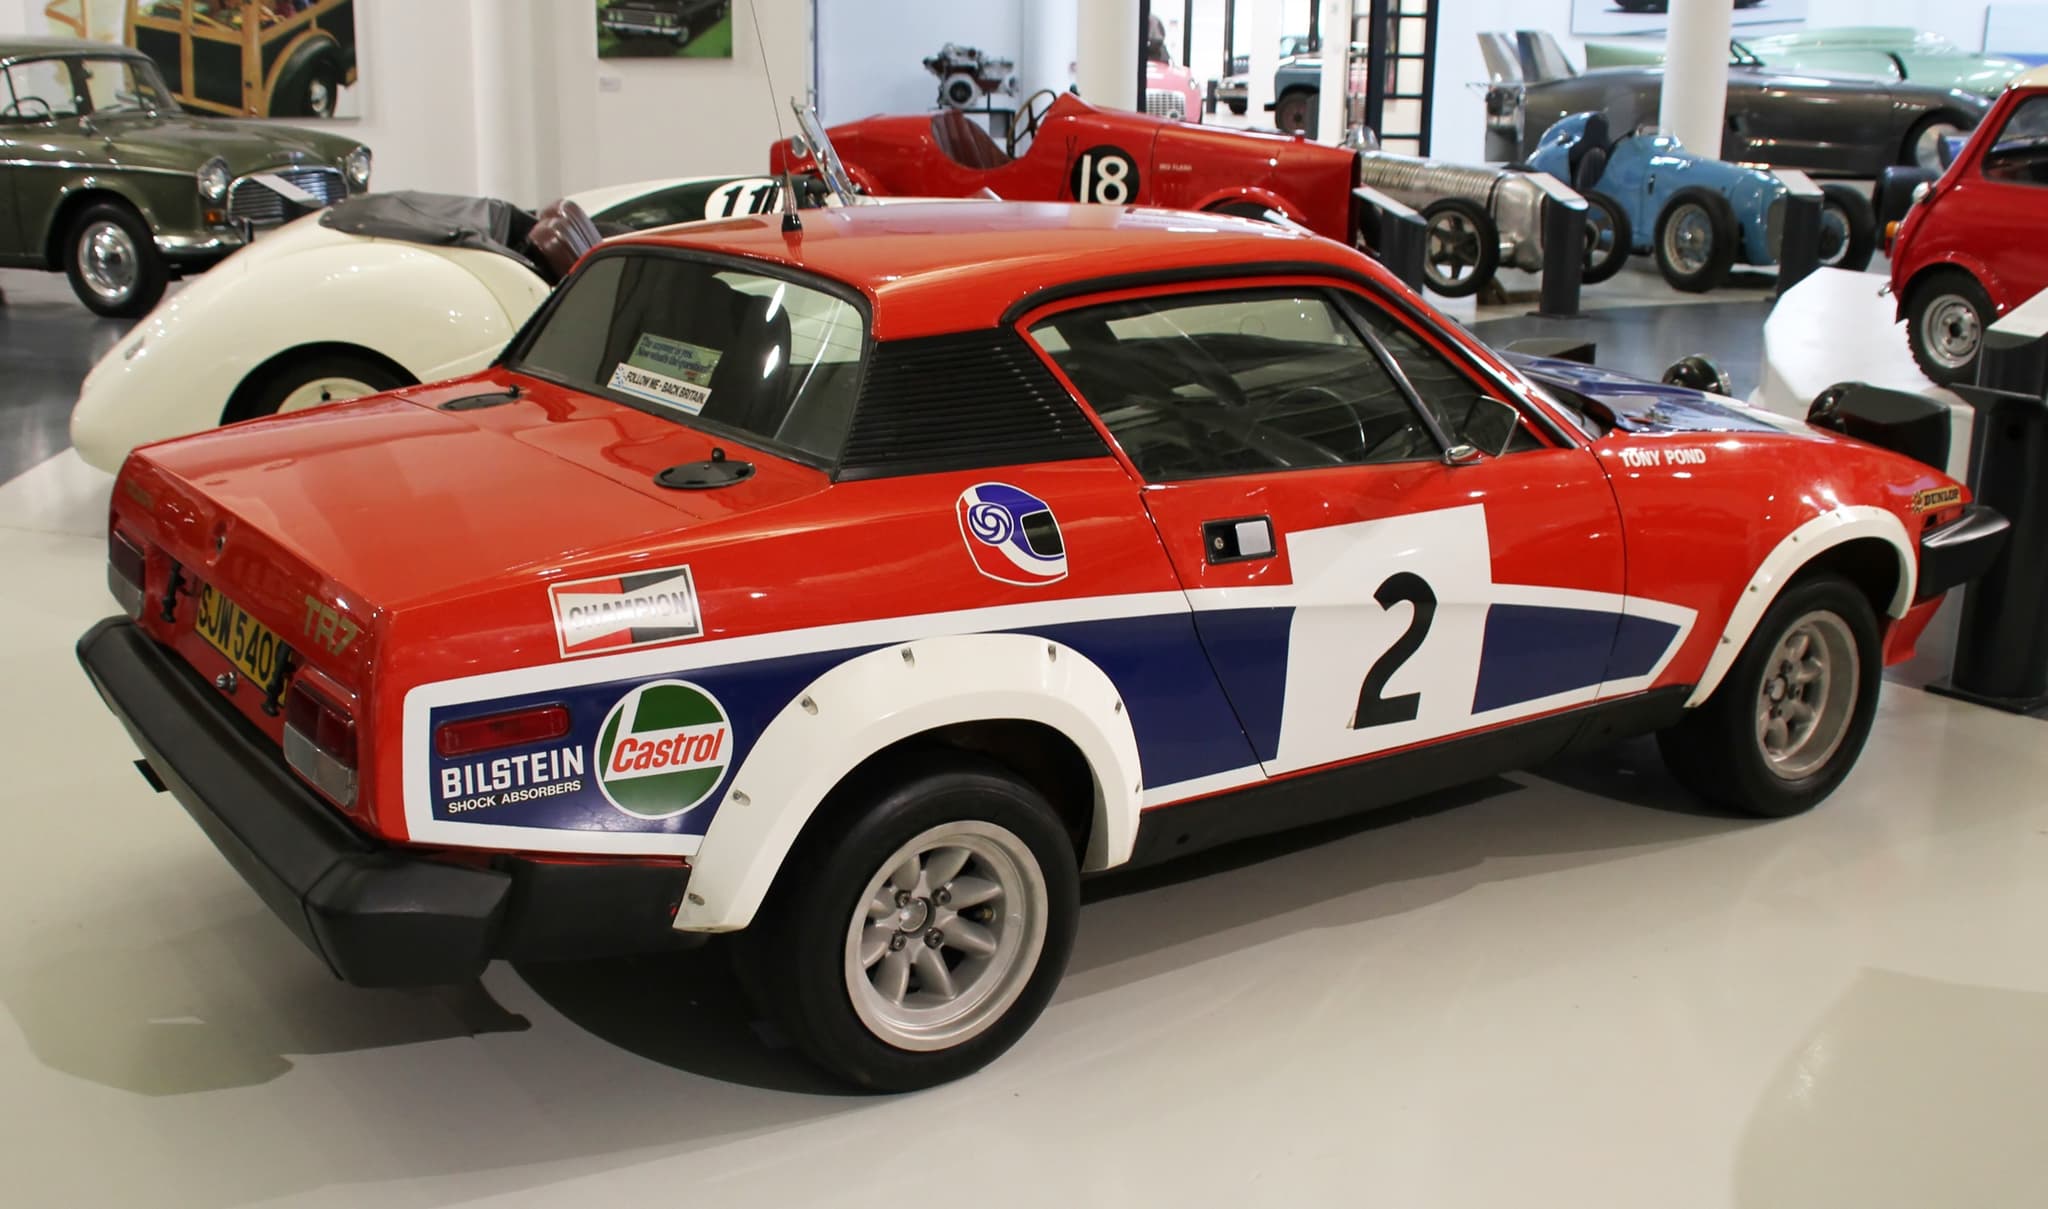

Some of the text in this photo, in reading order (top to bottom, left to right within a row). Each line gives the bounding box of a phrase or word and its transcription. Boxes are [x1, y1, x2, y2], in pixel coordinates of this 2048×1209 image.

[1080, 154, 1129, 205] 18
[721, 185, 771, 217] 11
[661, 382, 682, 396] BACK
[1618, 448, 1706, 467] TONY POND
[1924, 488, 1959, 506] DUNLOP
[199, 583, 234, 650] SJW
[304, 595, 359, 656] TR7
[569, 591, 688, 630] CHAMPION
[1353, 571, 1437, 730] 2
[612, 728, 725, 773] Castrol
[441, 745, 584, 799] BILSTEIN
[448, 780, 581, 813] SHOCK ABSORBERS
